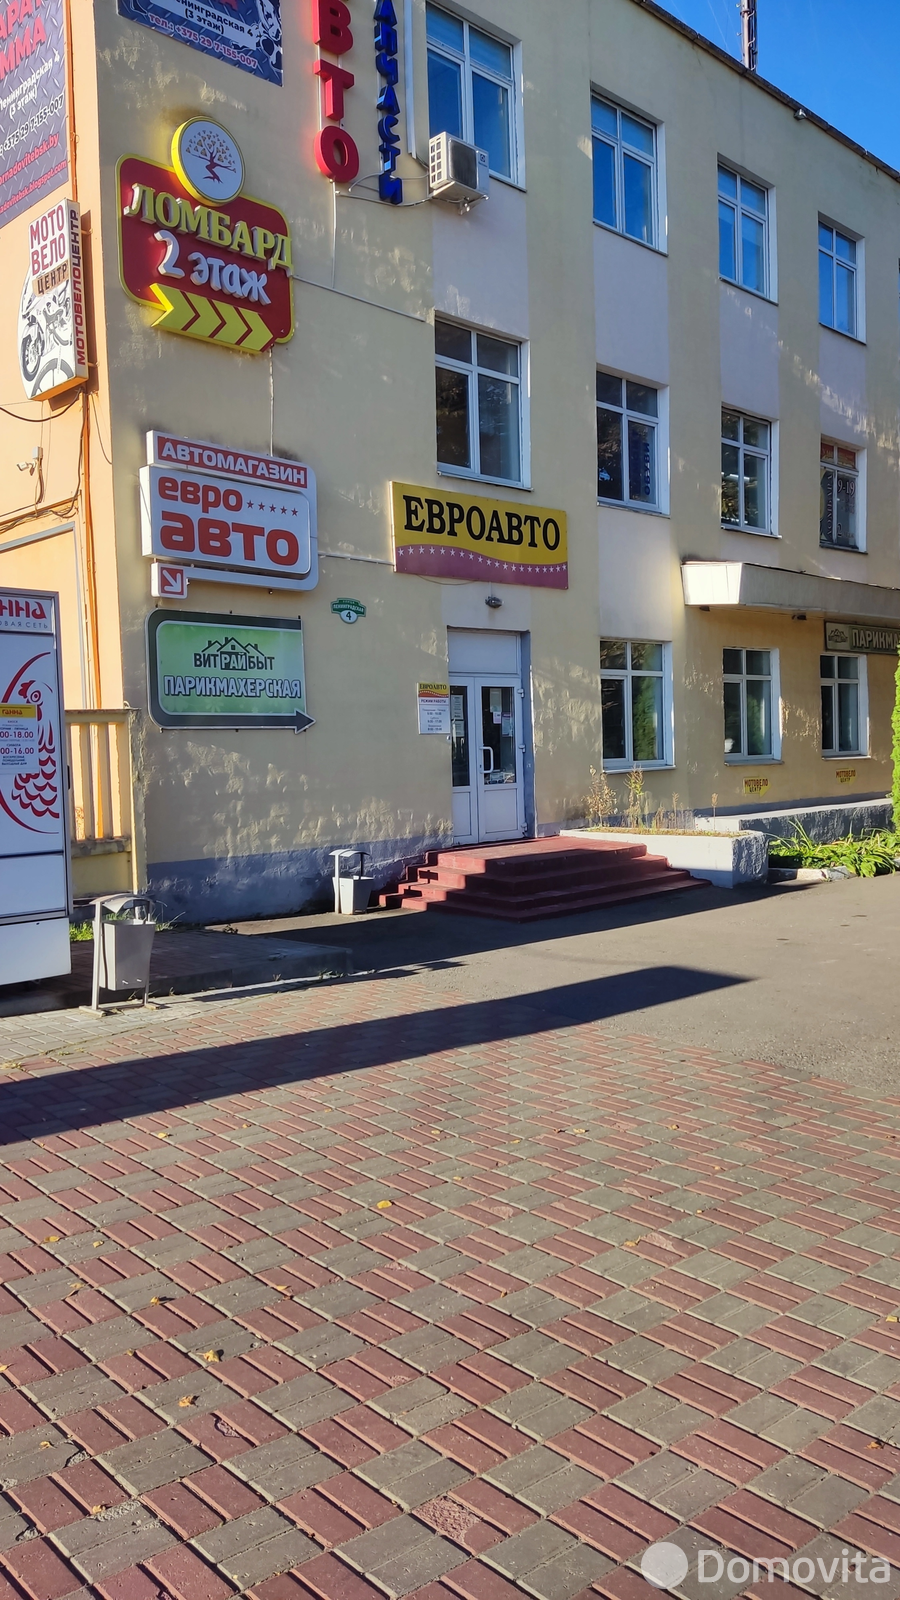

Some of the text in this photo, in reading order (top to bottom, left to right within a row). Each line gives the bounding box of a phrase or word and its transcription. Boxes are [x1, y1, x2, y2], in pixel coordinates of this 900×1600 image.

[149, 14, 259, 69] тел.: +375 29 7-155-007
[185, 8, 224, 34] (3 этаж)
[312, 0, 360, 182] ВТО
[20, 121, 29, 140] 29
[30, 92, 64, 132] 7-155-007
[30, 204, 65, 249] МОТО
[124, 183, 294, 278] ЛОМБАРД
[31, 232, 66, 277] ВЕЛО
[154, 229, 272, 306] 2 этаж
[37, 263, 68, 296] ЦЕНТР
[70, 209, 87, 366] МОТОВЕЛОЦЕНТР
[161, 441, 306, 485] АВТОМАГАЗИН
[402, 494, 561, 550] ЕВРОАВТО
[345, 611, 352, 621] 4
[163, 675, 302, 698] ПАРИКМАХЕРСКАЯ
[744, 778, 768, 787] МОТОВЕЛО
